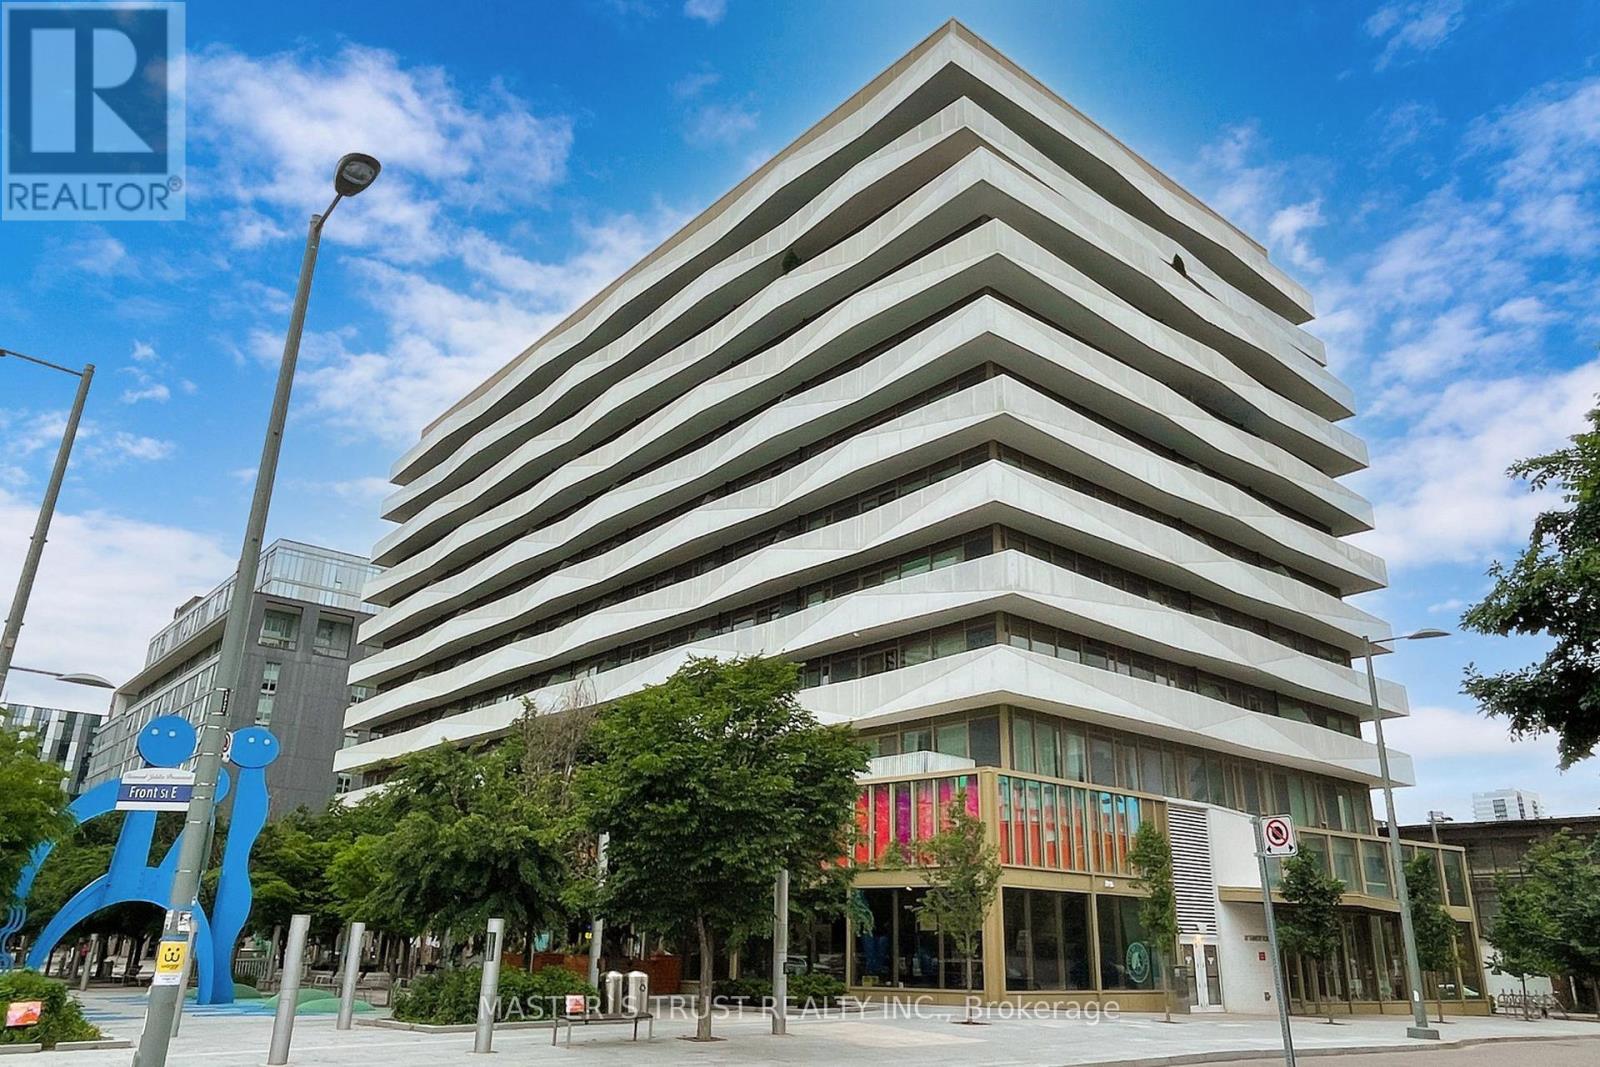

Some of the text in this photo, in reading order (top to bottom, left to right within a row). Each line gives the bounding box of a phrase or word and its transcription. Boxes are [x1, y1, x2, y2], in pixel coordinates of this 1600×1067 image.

[129, 786, 178, 799] Front St E
